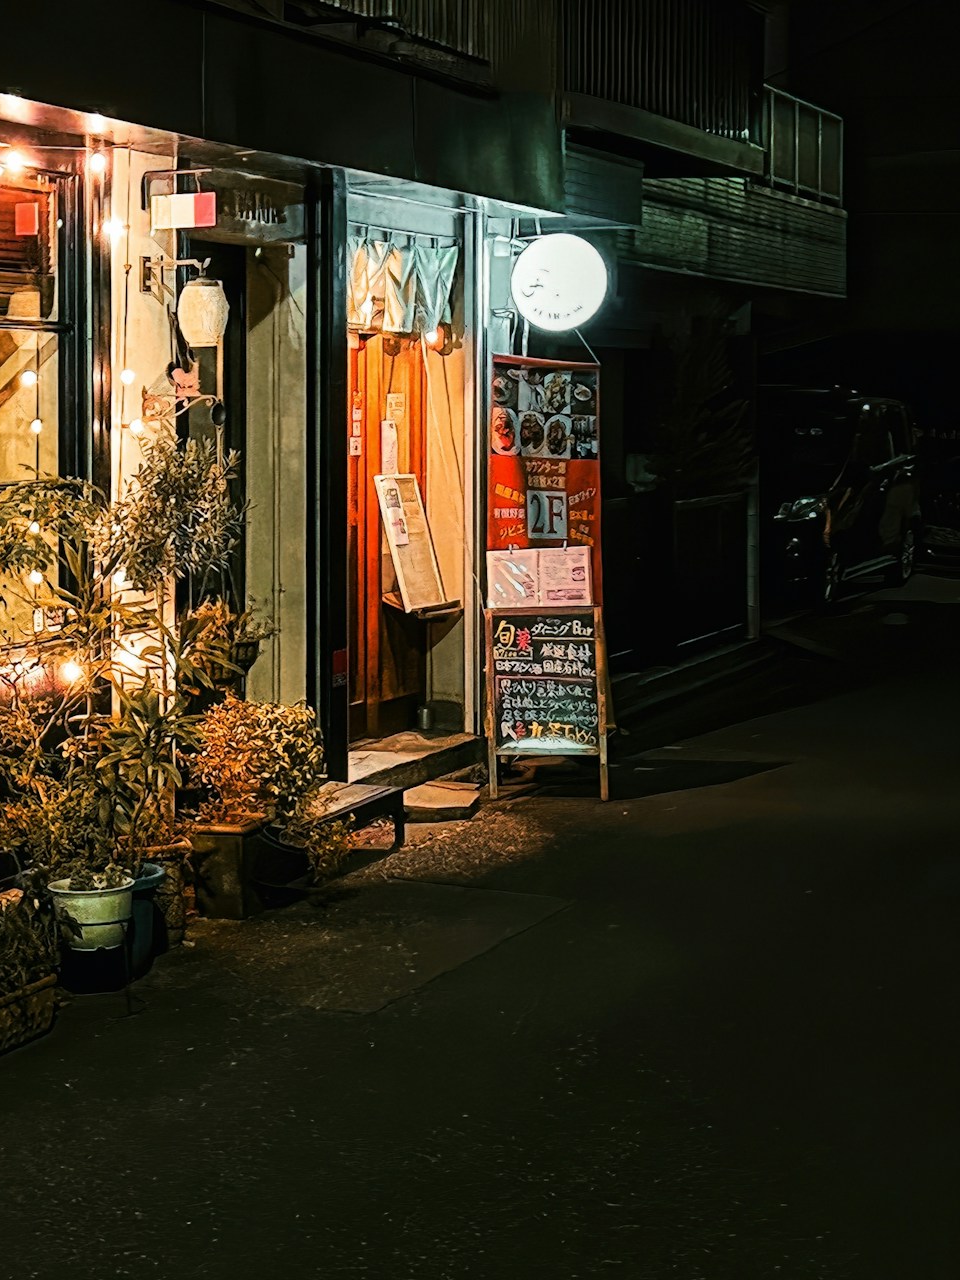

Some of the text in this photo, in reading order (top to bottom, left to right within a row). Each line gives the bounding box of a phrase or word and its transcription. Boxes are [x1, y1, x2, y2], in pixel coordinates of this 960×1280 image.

[530, 494, 564, 534] 2F
[530, 622, 572, 636] ダイニング
[572, 620, 593, 636] Bar
